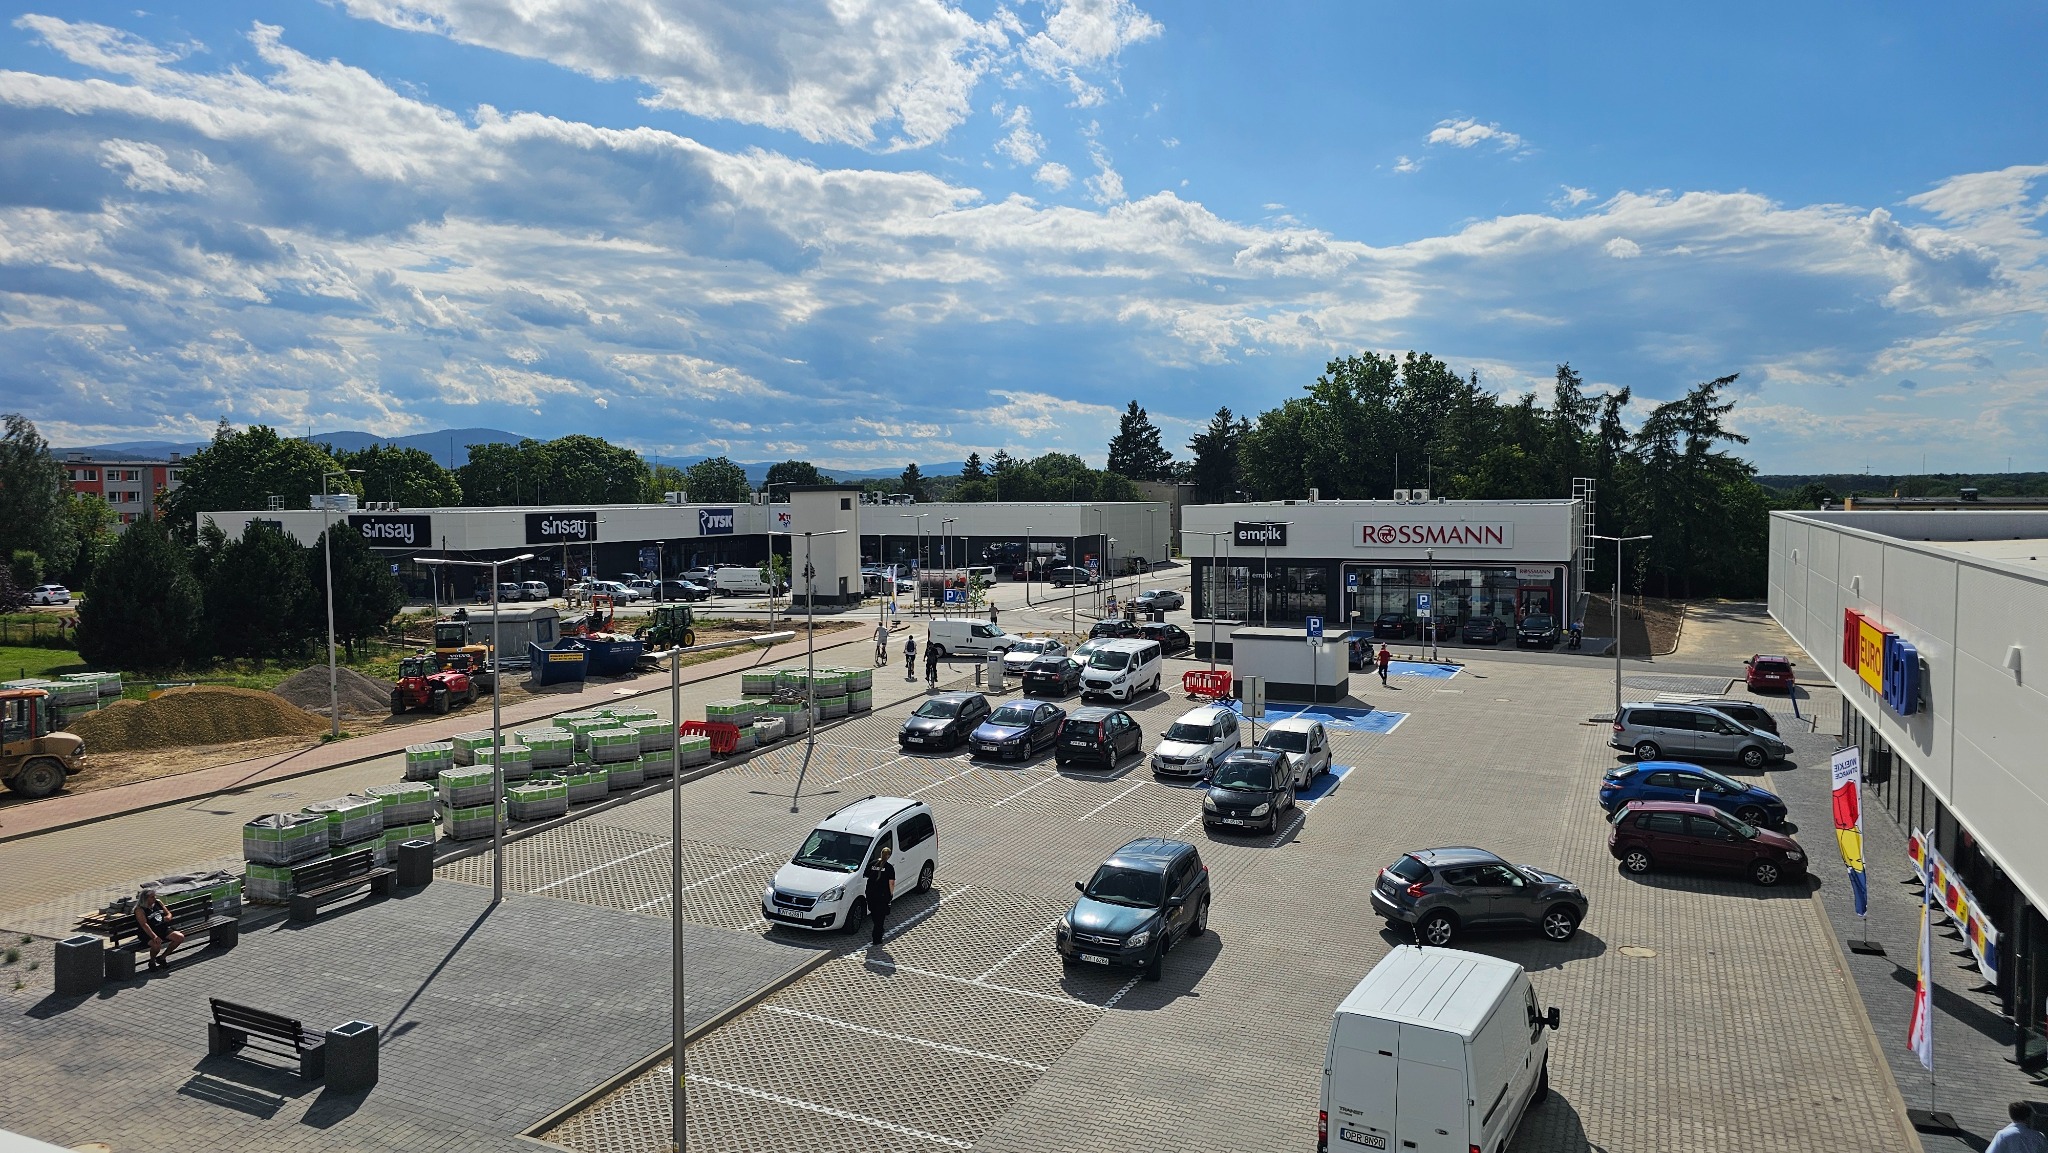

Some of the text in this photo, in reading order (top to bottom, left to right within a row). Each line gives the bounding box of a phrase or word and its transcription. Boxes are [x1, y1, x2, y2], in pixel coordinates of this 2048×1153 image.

[541, 515, 587, 539] sinsay
[707, 515, 733, 528] JYSK
[362, 518, 415, 544] sinsay
[1238, 525, 1282, 542] empik
[1362, 525, 1503, 545] ROSSMANN
[1251, 570, 1273, 580] empik
[1349, 574, 1356, 583] P
[946, 590, 954, 601] P
[1419, 595, 1428, 606] P
[1310, 618, 1320, 632] P
[1860, 635, 1881, 677] EURO
[1345, 1130, 1384, 1148] OPR 8N90
